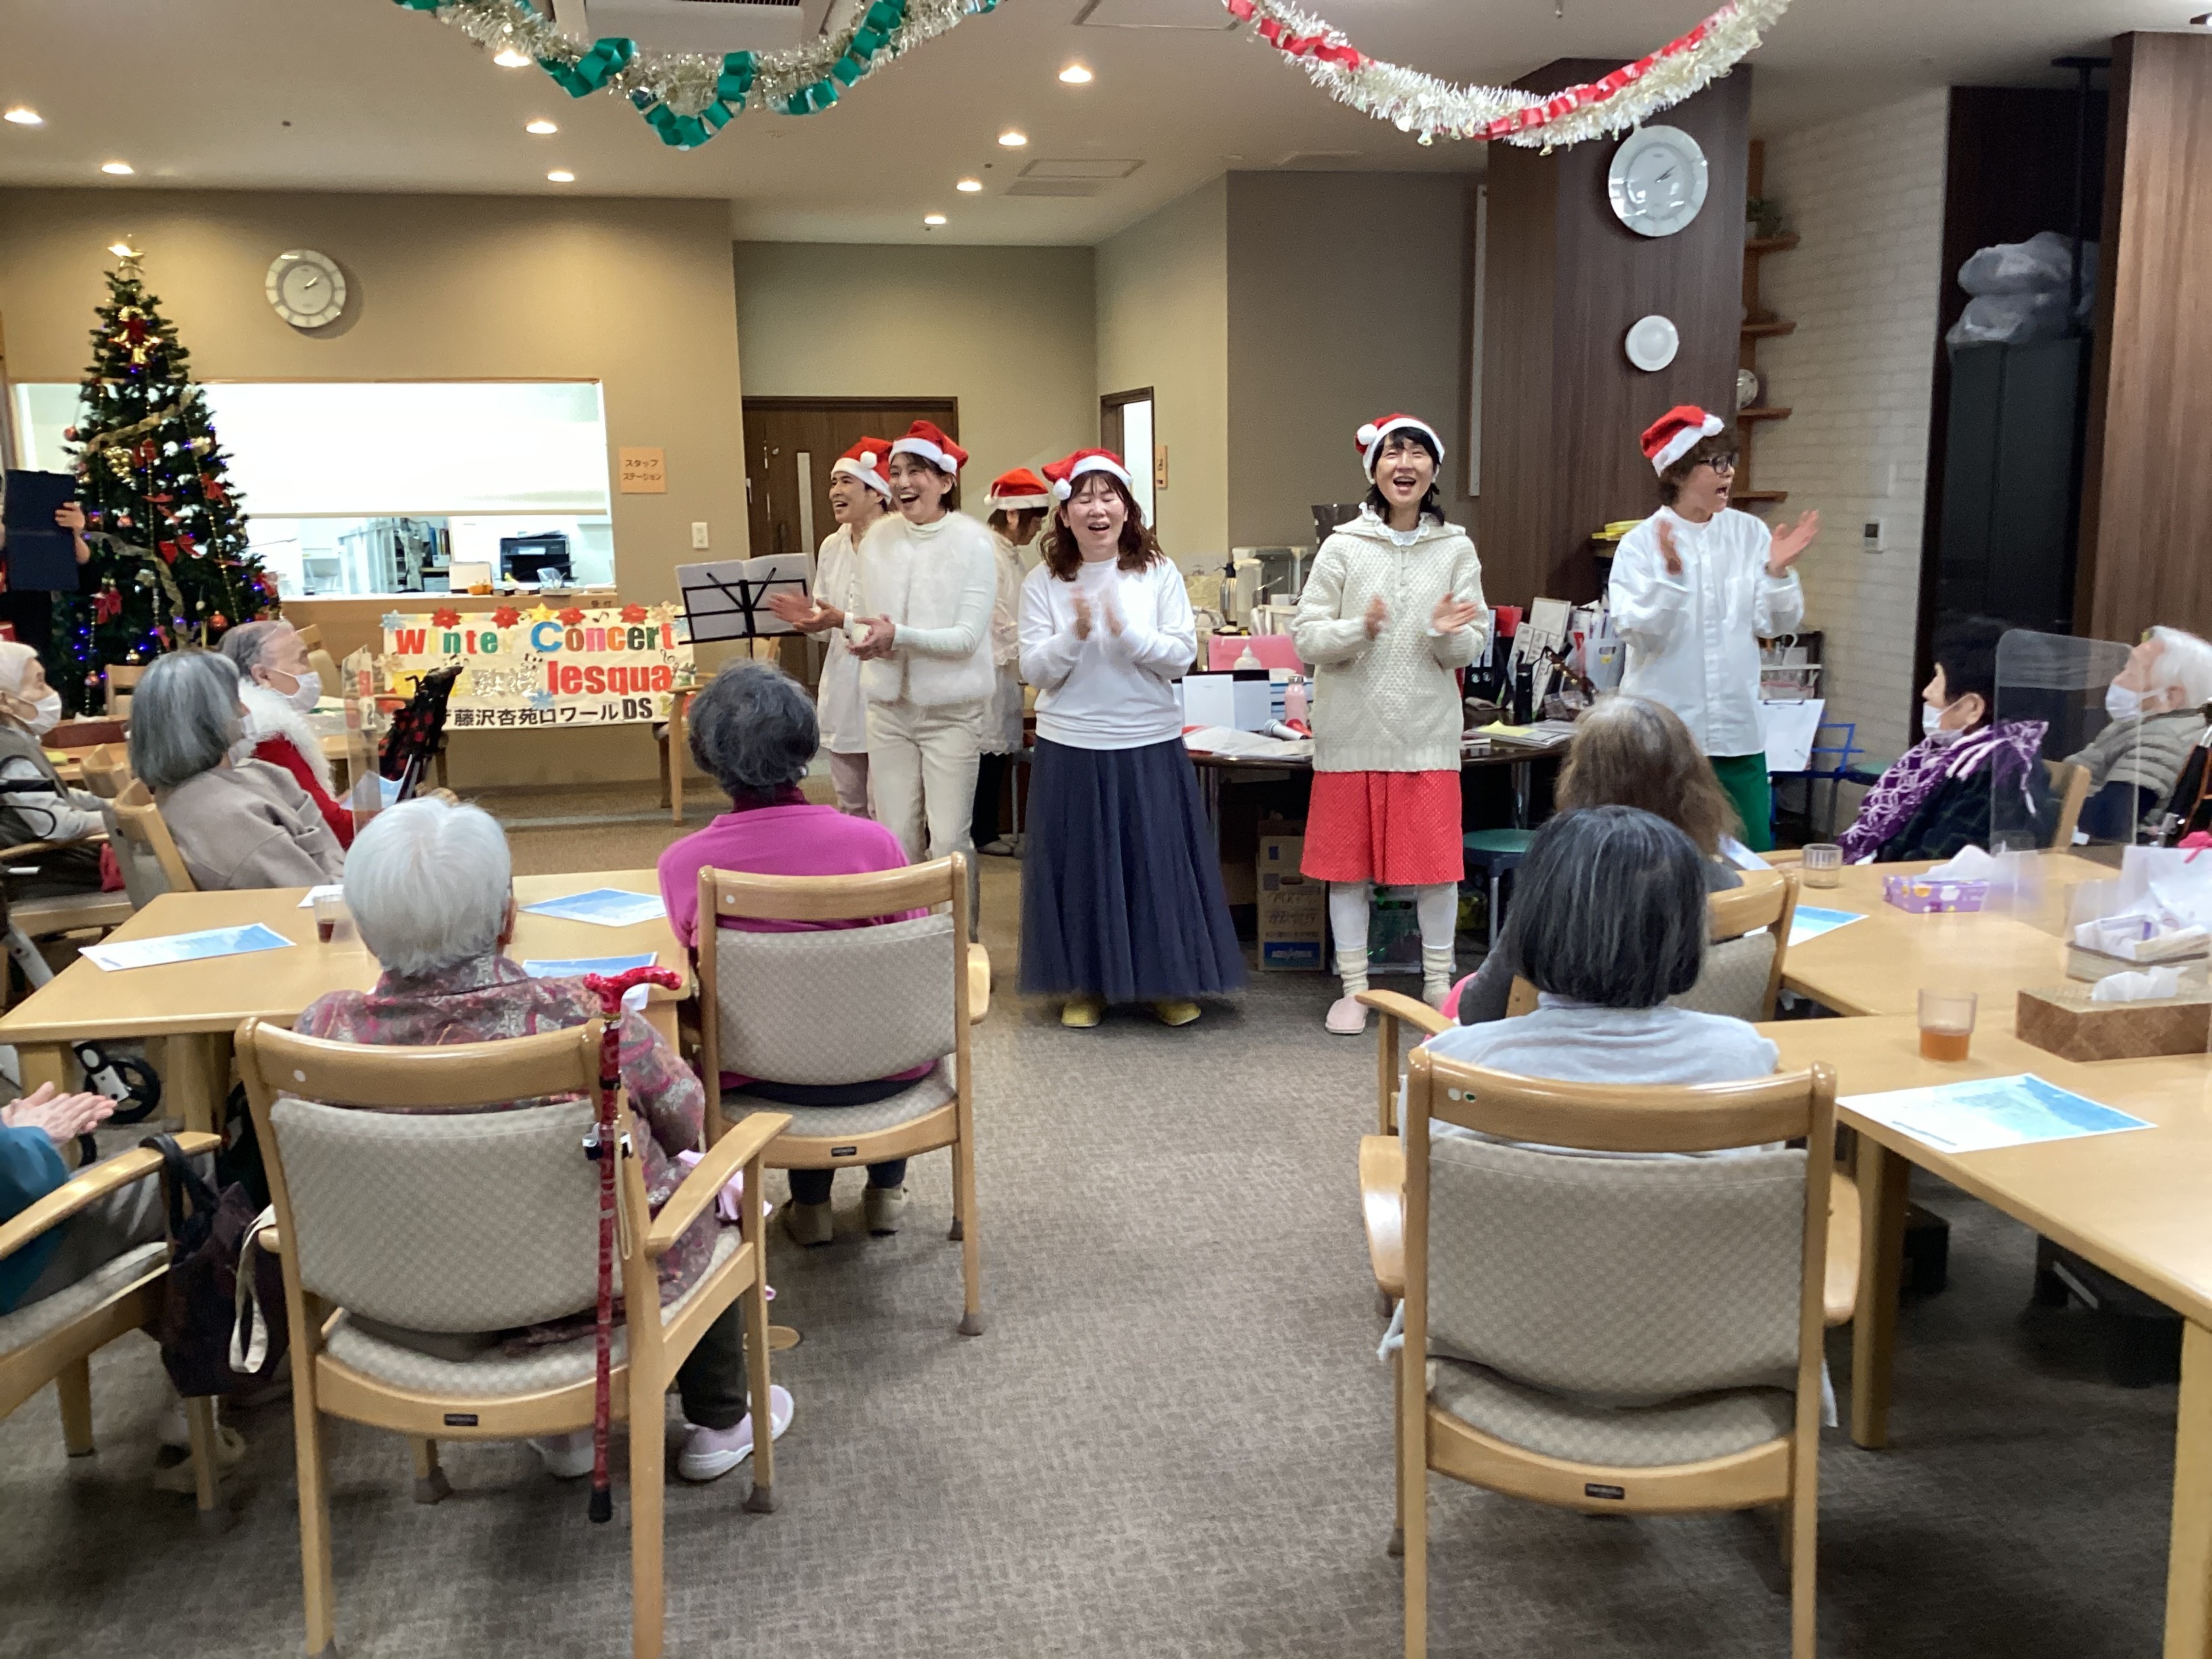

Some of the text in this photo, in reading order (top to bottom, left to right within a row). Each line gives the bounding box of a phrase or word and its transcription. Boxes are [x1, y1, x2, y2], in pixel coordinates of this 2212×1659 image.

[625, 459, 659, 468] スタッフ
[623, 472, 661, 481] ステーション
[531, 621, 675, 653] Concert
[548, 660, 673, 696] lesqua
